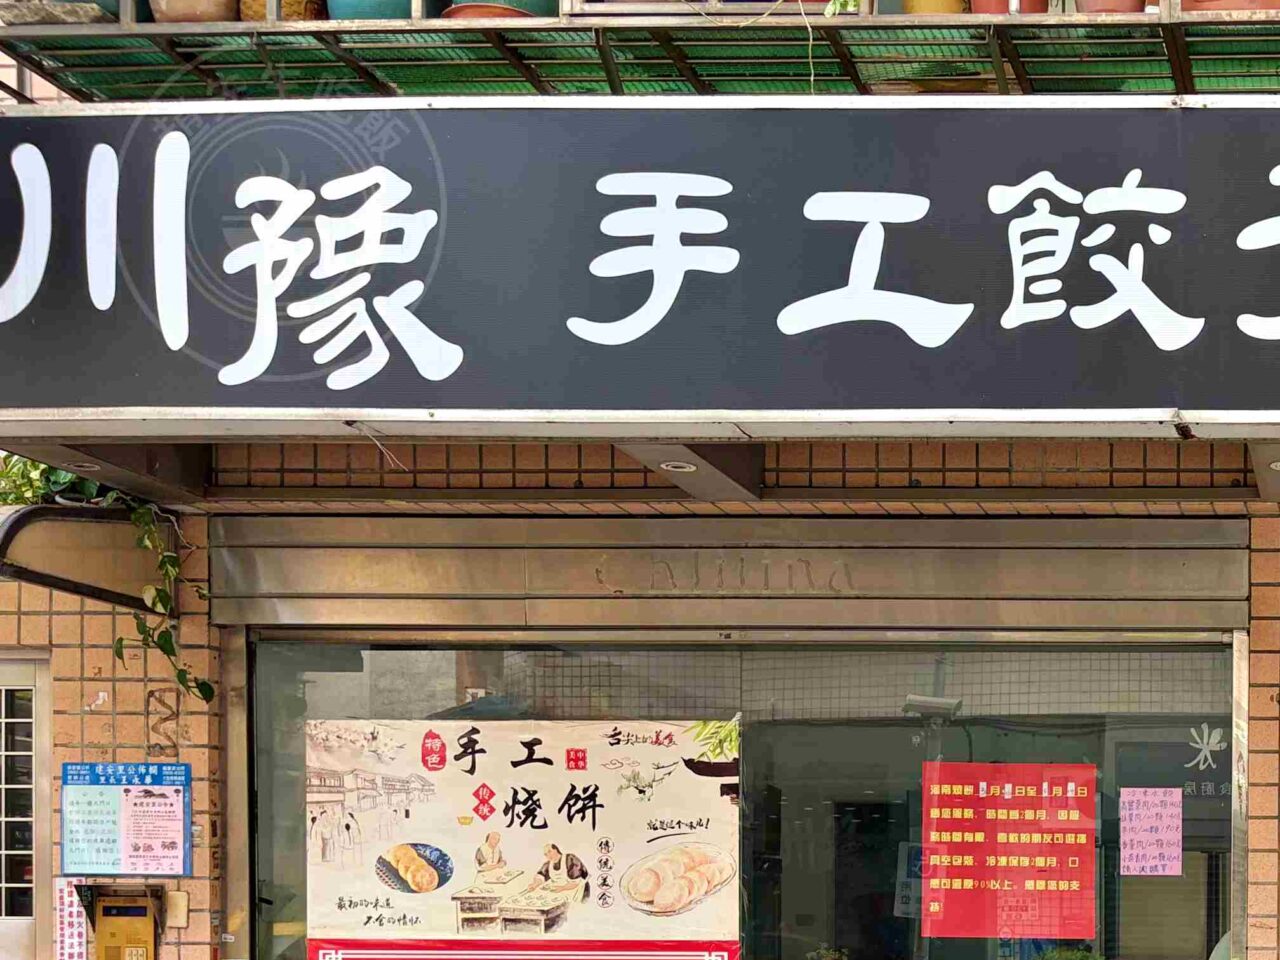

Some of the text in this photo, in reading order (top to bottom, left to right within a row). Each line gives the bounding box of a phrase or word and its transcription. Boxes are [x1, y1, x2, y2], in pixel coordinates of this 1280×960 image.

[0, 130, 465, 391] 川豫
[453, 726, 554, 776] 手工
[502, 783, 605, 832] 烧饼
